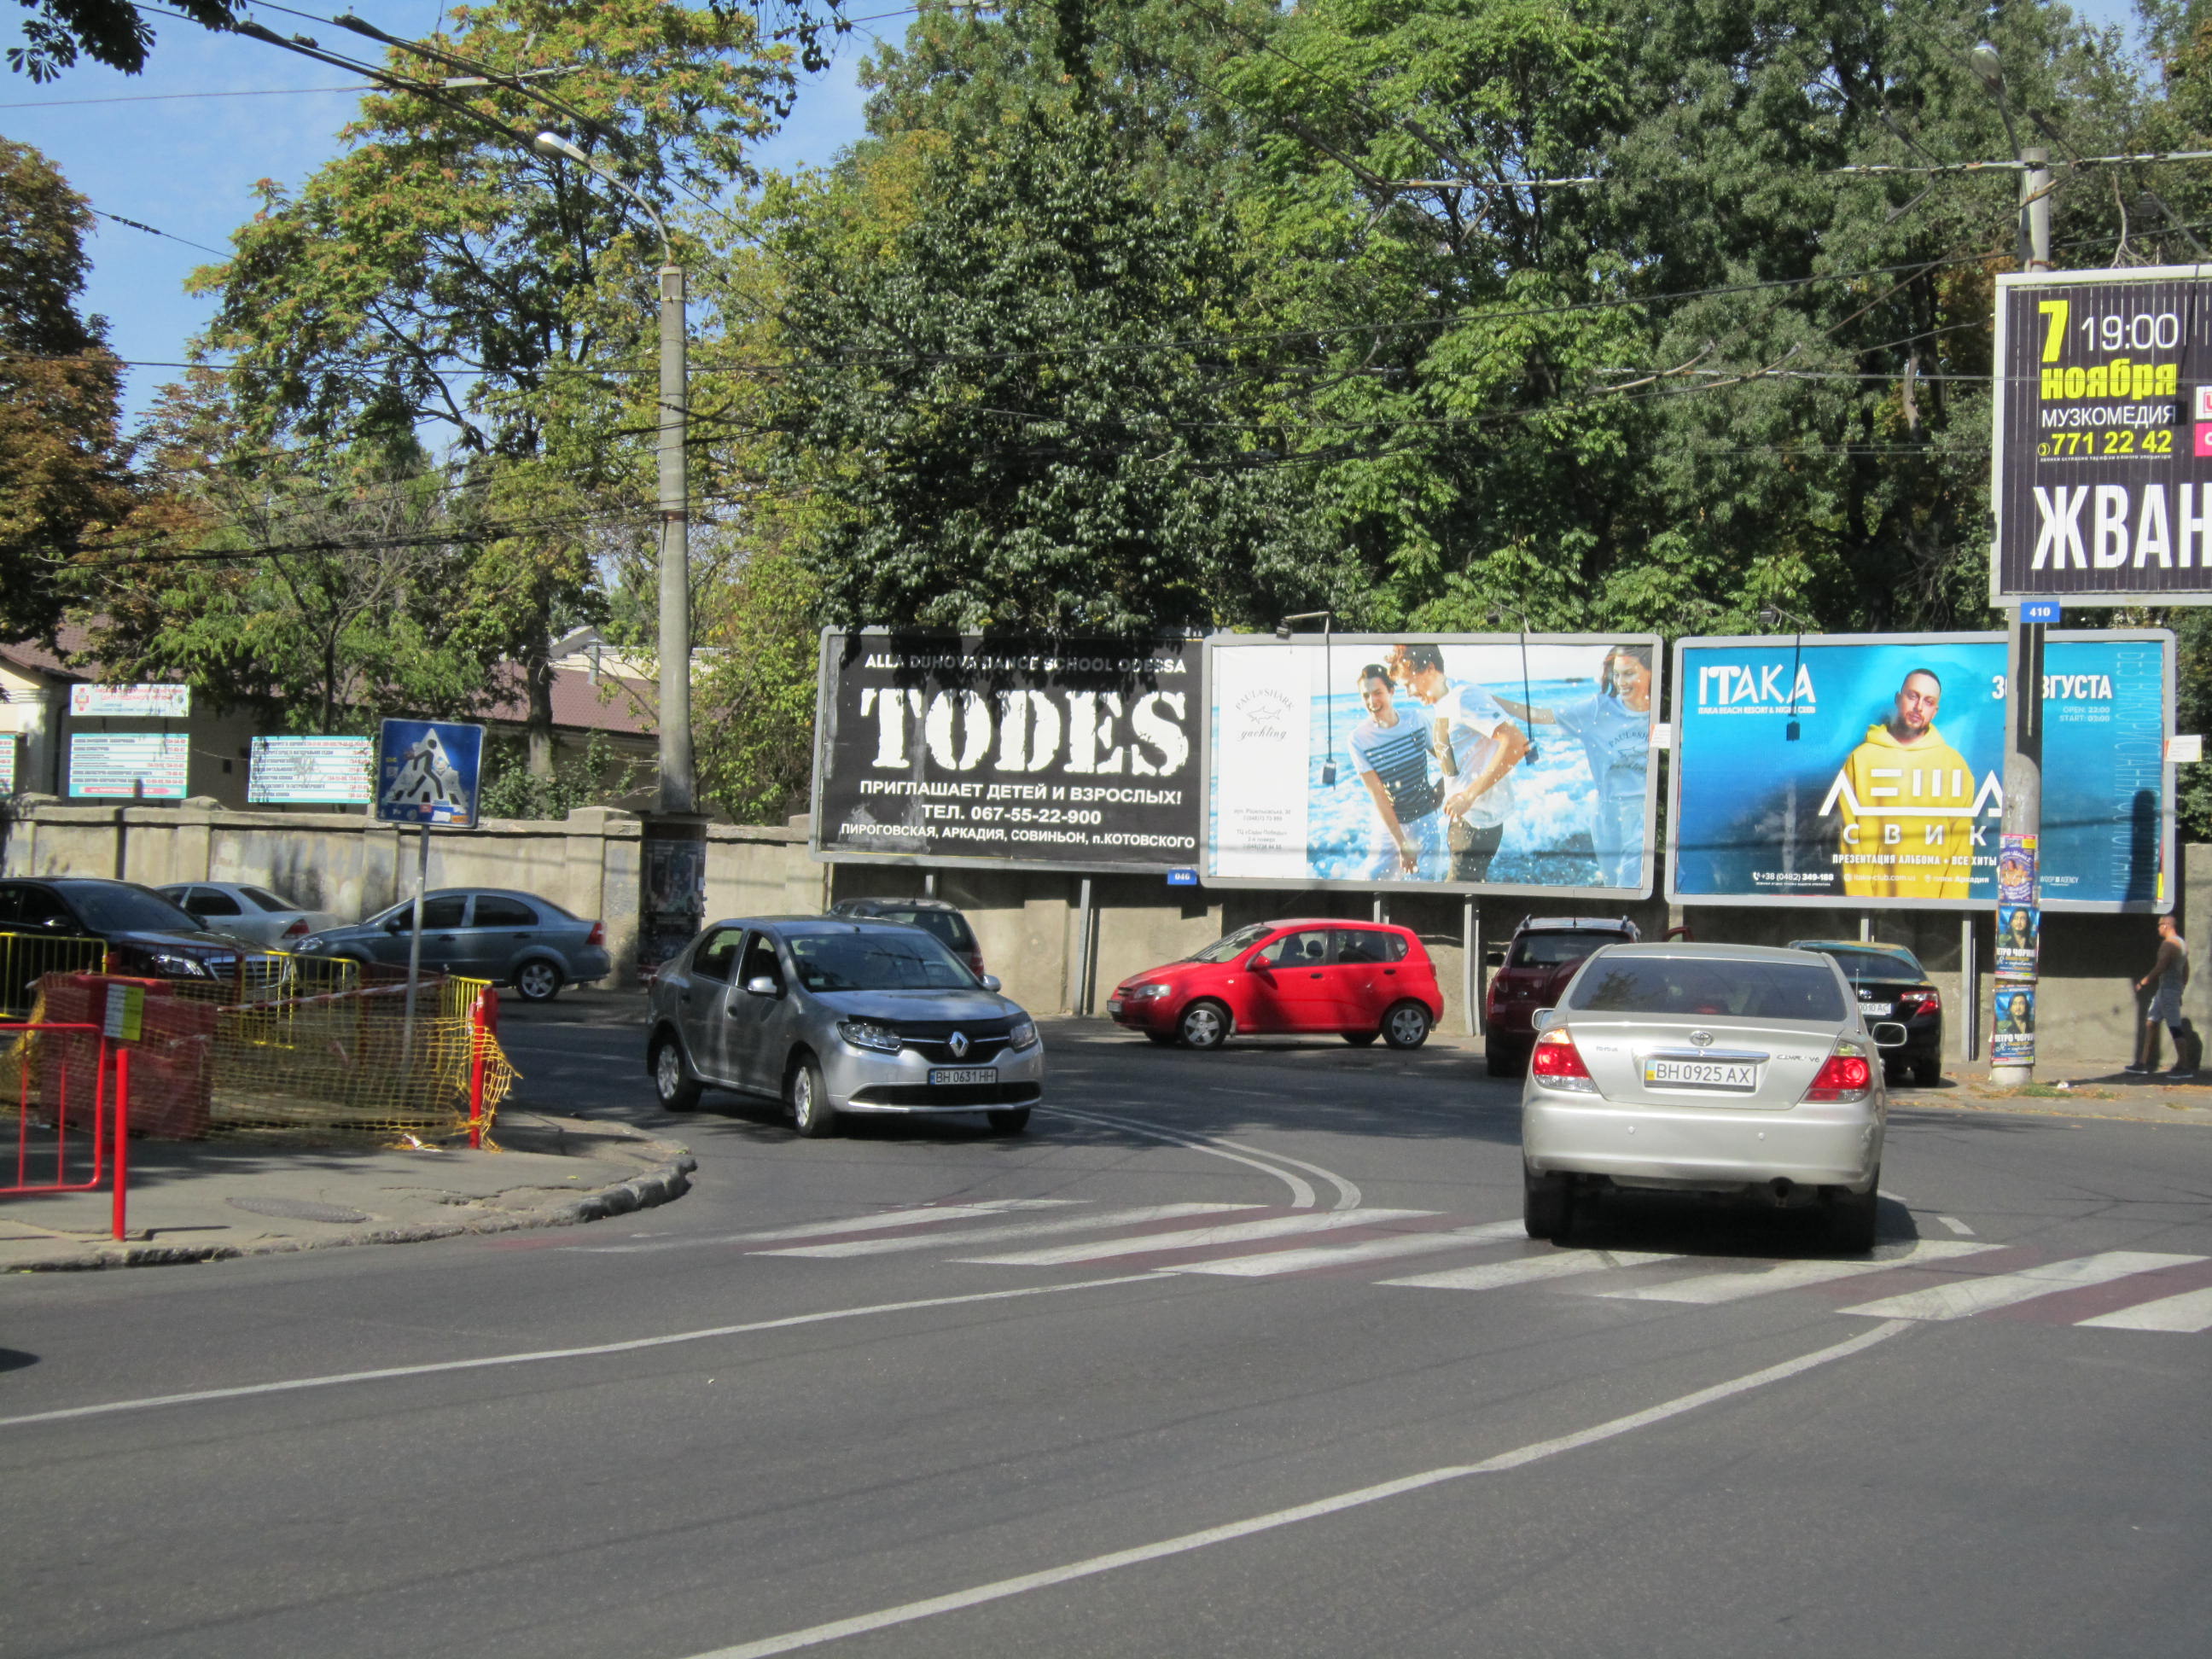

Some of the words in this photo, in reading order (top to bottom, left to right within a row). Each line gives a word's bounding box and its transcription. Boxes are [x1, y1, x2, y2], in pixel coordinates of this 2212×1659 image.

[2039, 300, 2069, 362] 7
[2081, 313, 2179, 351] 19:00
[2040, 358, 2177, 400] ноября
[2041, 405, 2175, 428] МУЗКОМЕДИЯ
[2051, 432, 2094, 456] 771
[2104, 431, 2133, 453] 22
[2141, 430, 2172, 453] 42
[2031, 483, 2212, 569] ЖВАН
[2029, 607, 2051, 616] 410
[864, 654, 904, 668] ALLA
[1044, 656, 1113, 672] SCHOOL
[1118, 657, 1187, 673] ODESSA
[1699, 663, 1816, 705] ITAKA
[1992, 675, 2007, 699] 3
[2043, 675, 2113, 699] ВГУСТА
[860, 688, 1189, 777] TODES
[860, 780, 983, 797] ПРИГЛАШАЕТ
[987, 783, 1046, 800] ДЕТЕЙ
[1052, 786, 1065, 800] И
[1070, 787, 1182, 805] ВЗРОСЛЫХ!
[922, 804, 965, 819] ТЕЛ.
[971, 806, 1102, 825] 067-55-22-900
[841, 823, 939, 839] ПИРОГОВСКАЯ,
[942, 827, 1008, 841] АРКАДИЯ,
[1010, 830, 1089, 845] СОВИНЬОН,
[1092, 833, 1195, 848] п.КОТОВСКОГО
[1832, 853, 1896, 865] ПРЕЗЕНТАЦИЯ
[1898, 854, 1941, 865] АЛЬБОМА
[1952, 855, 1968, 865] ВСЕ
[1971, 855, 1997, 865] ХИТЫ
[936, 1072, 951, 1083] BH
[953, 1072, 976, 1083] 0631
[979, 1071, 993, 1082] HH
[1656, 1063, 1679, 1079] BH
[1683, 1065, 1722, 1081] 0925
[1726, 1068, 1750, 1083] AX
